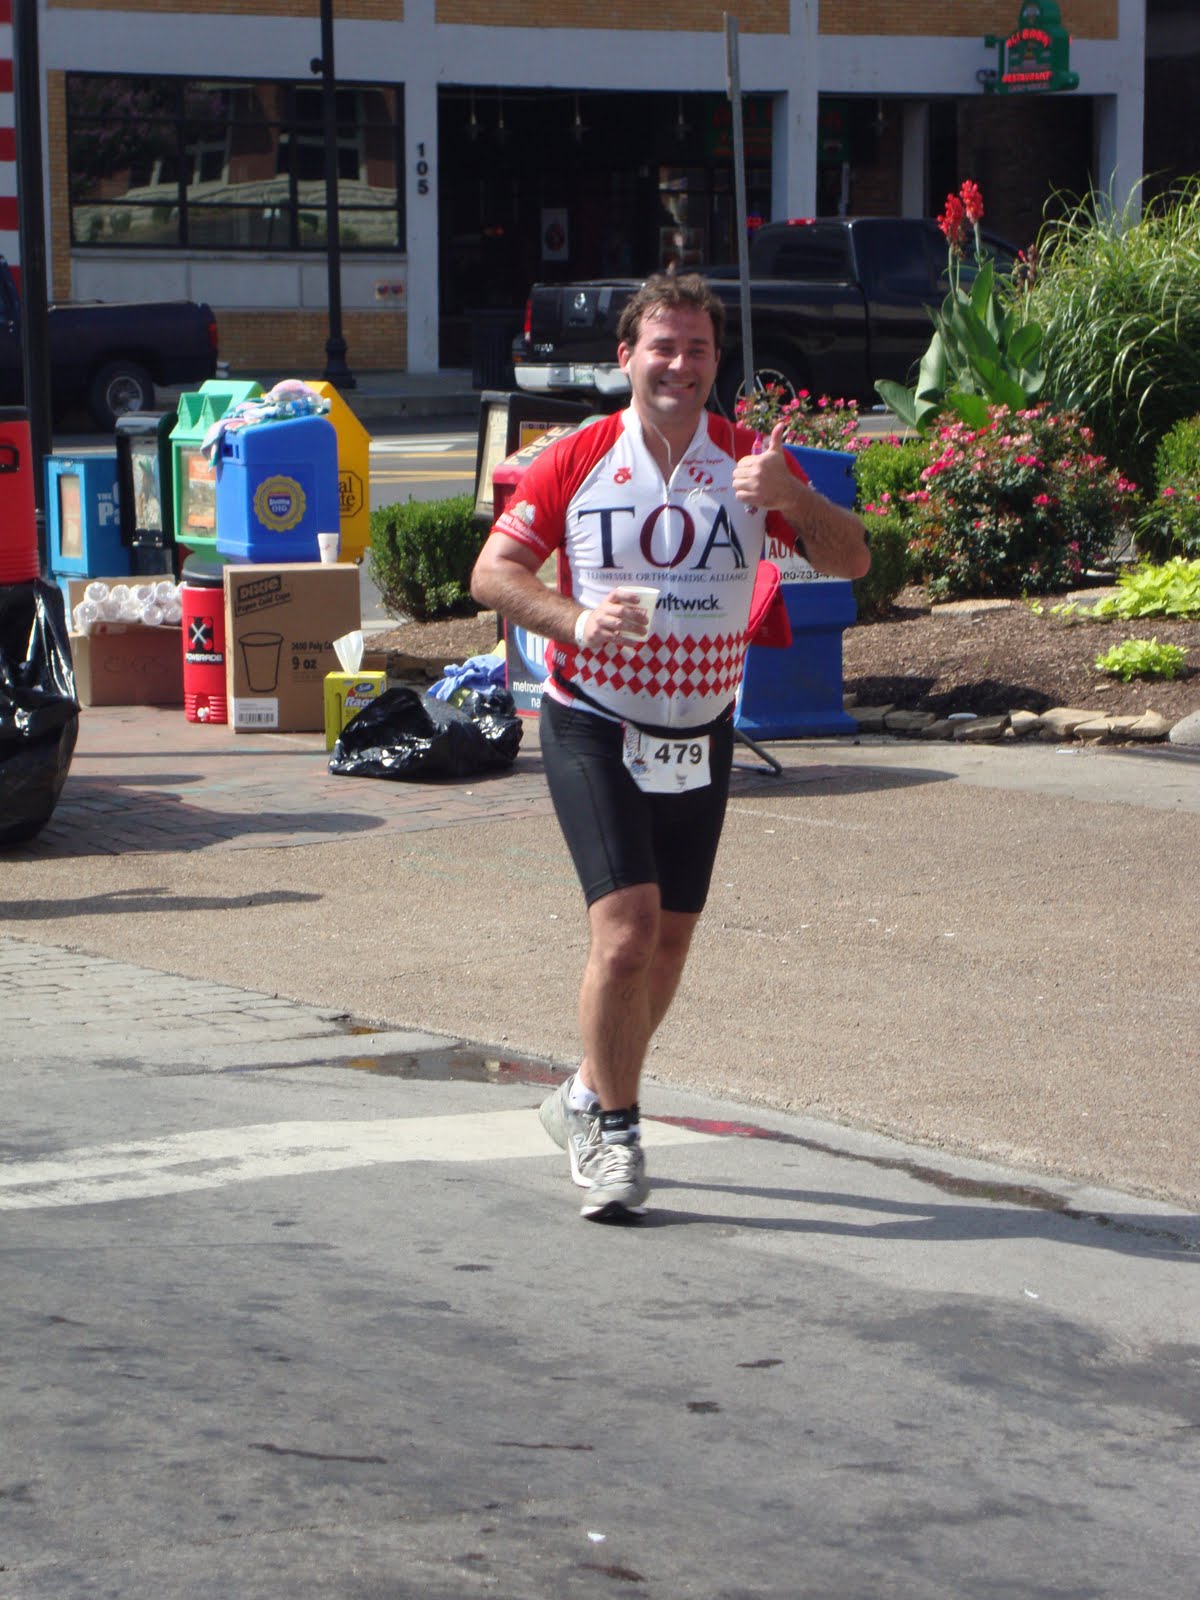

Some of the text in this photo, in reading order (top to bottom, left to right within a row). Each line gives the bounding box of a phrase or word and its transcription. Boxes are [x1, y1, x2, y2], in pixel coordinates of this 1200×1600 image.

[416, 142, 429, 196] 105
[503, 426, 571, 465] FREE
[578, 504, 749, 569] TOA
[654, 743, 703, 765] 479
